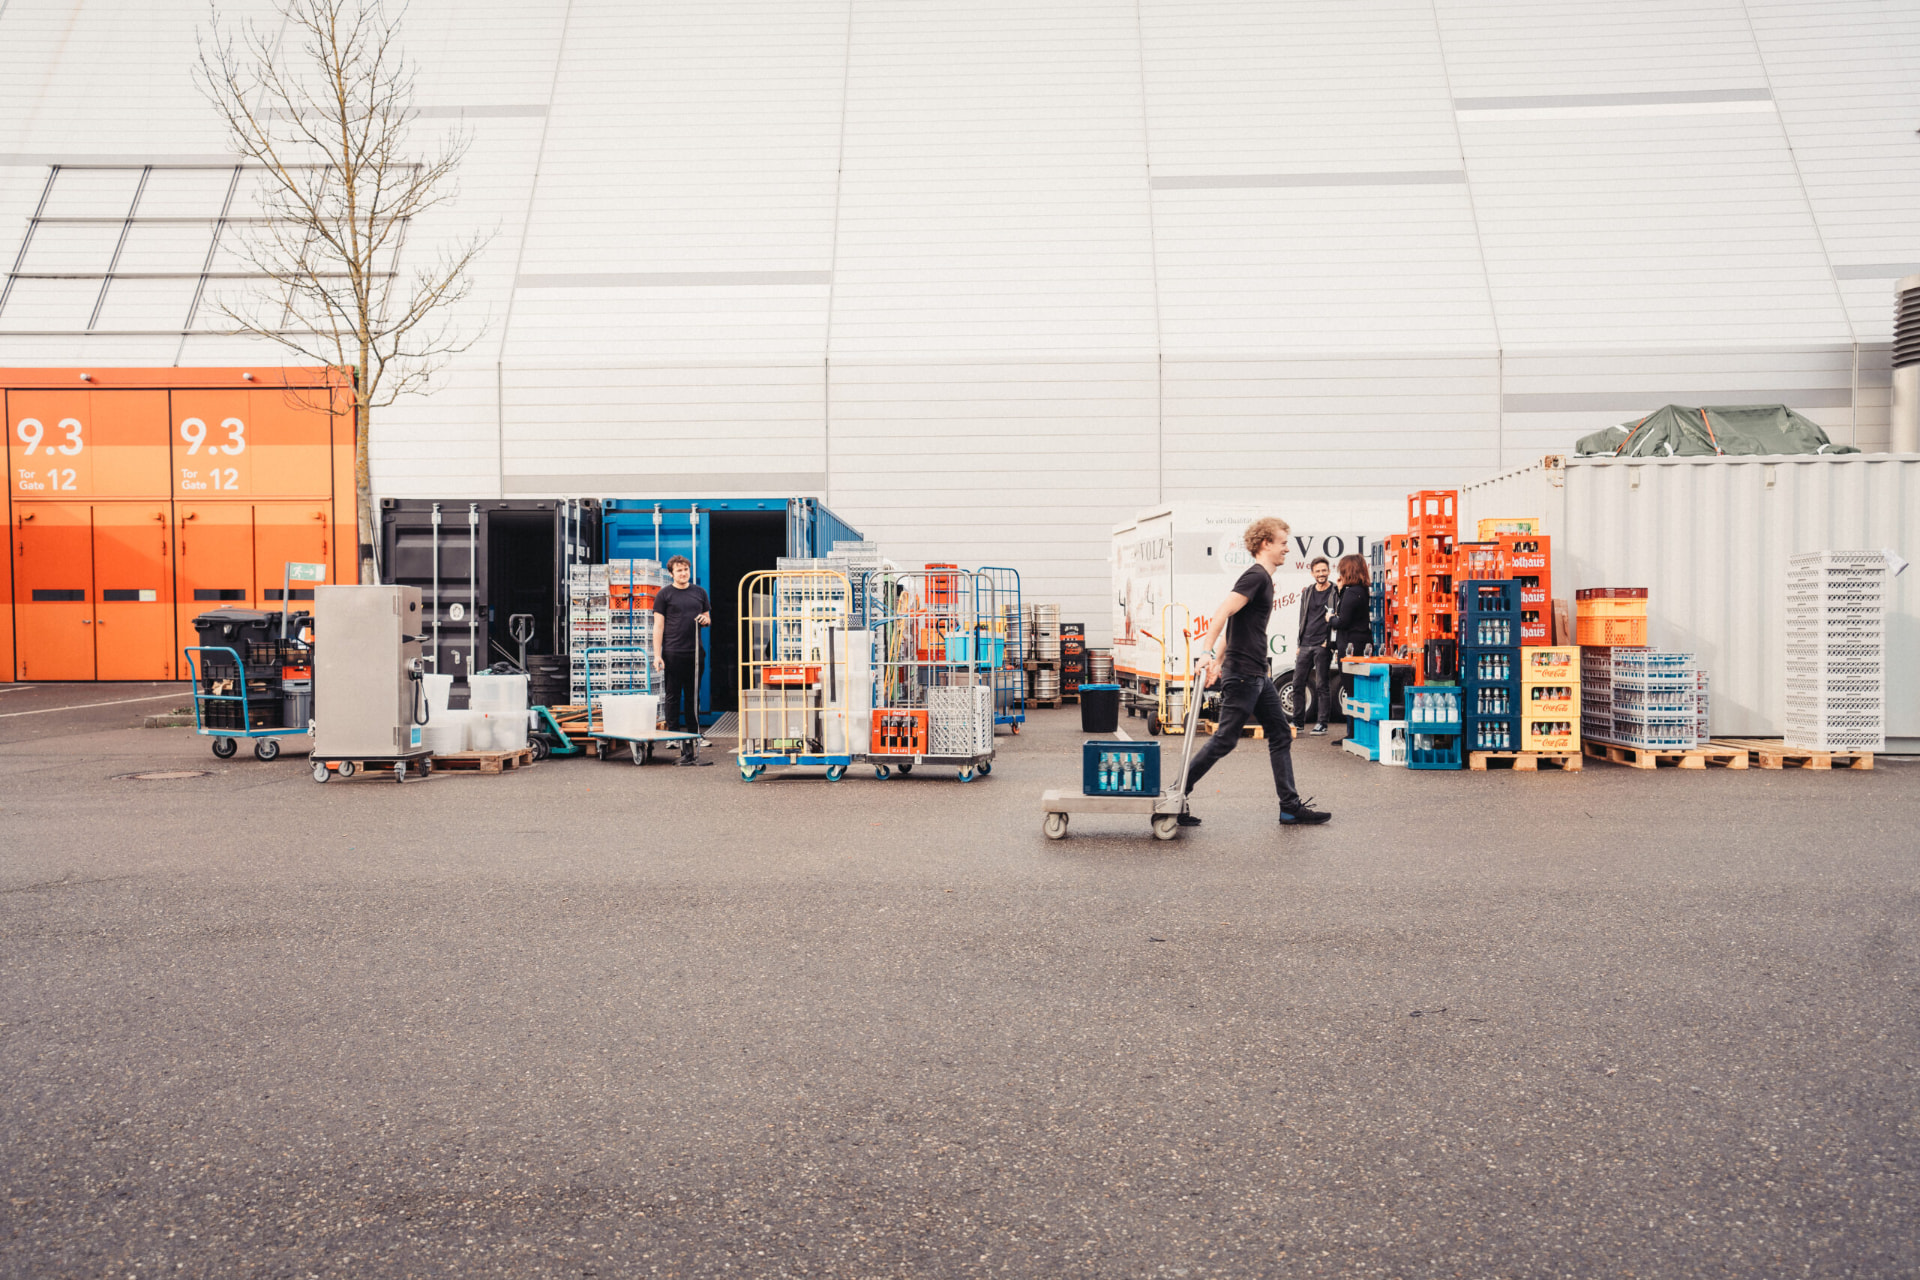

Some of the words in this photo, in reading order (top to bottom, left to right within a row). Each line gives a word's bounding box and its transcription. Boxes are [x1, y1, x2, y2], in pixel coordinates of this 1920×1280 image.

[17, 417, 83, 455] 9.3
[180, 417, 245, 455] 9.3
[18, 468, 36, 479] Tor
[47, 468, 77, 490] 12
[181, 468, 198, 479] Tor
[209, 468, 239, 490] 12
[19, 480, 45, 490] Gate
[181, 480, 207, 490] Gate
[1140, 538, 1165, 561] VOLZ
[1294, 535, 1371, 559] VOL
[1521, 591, 1545, 603] haus
[1521, 626, 1546, 638] haus
